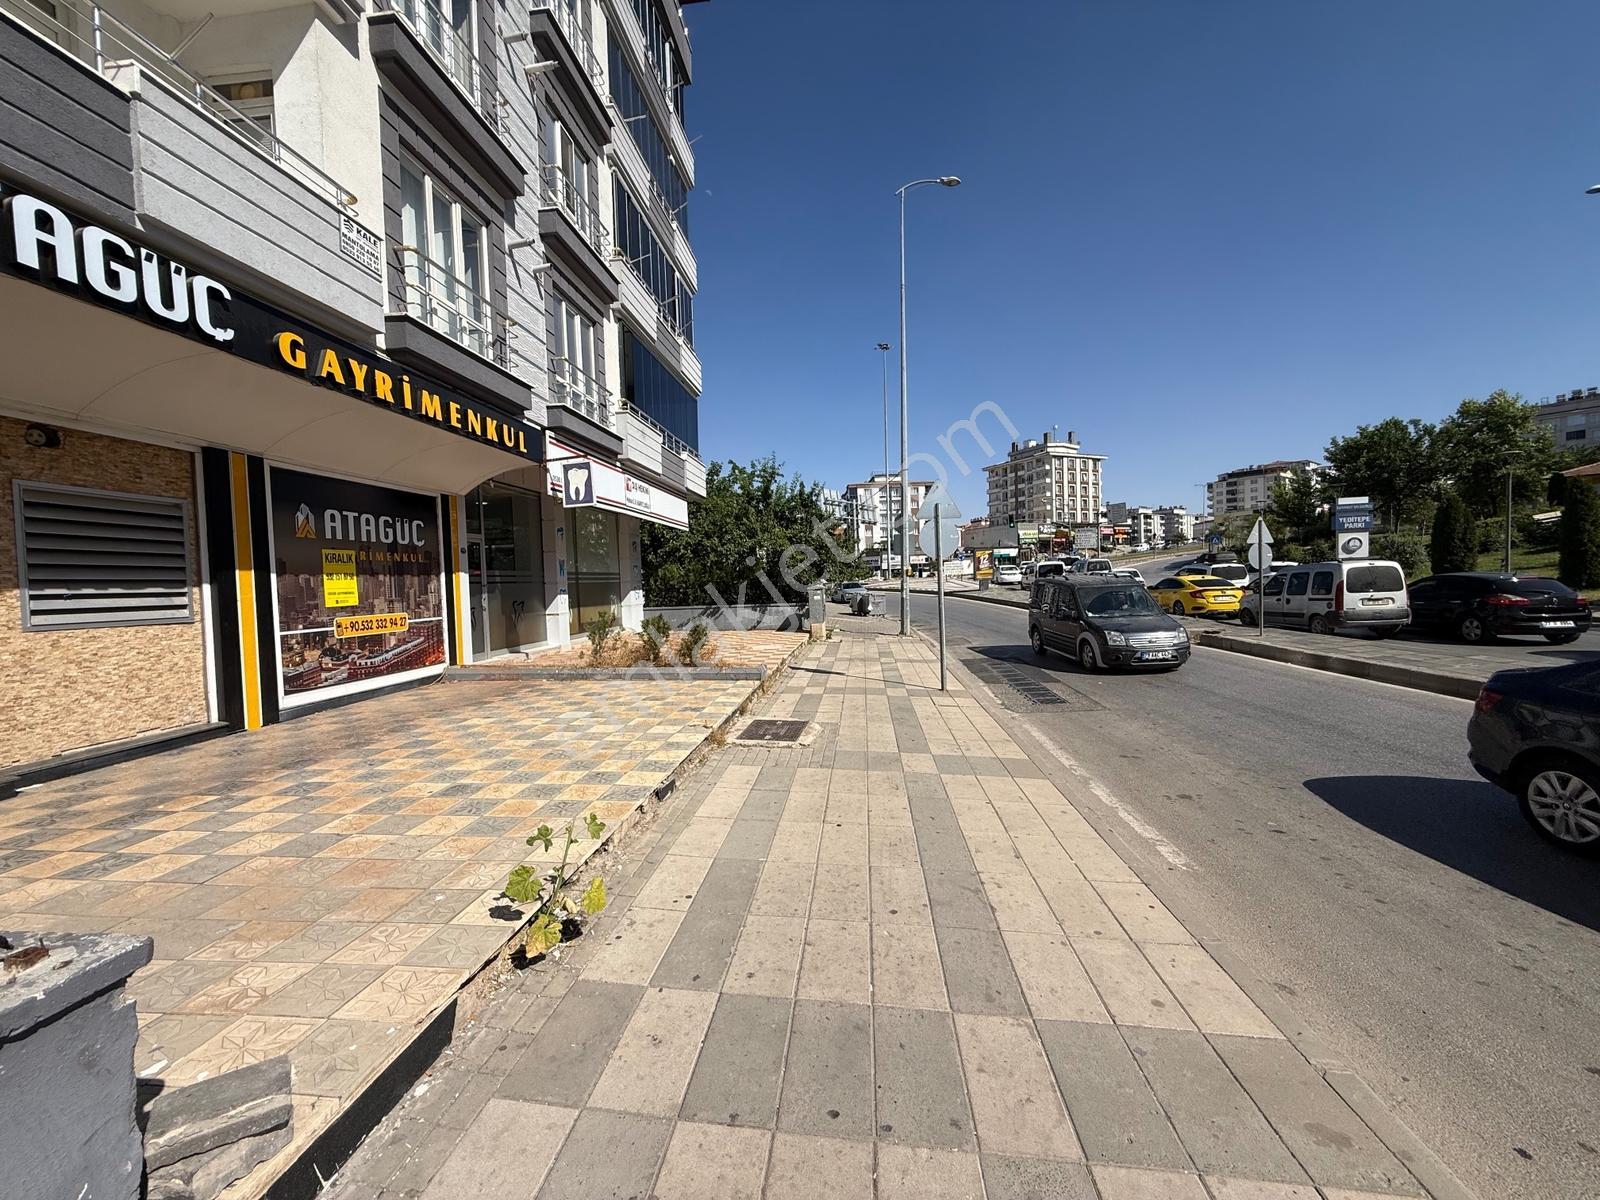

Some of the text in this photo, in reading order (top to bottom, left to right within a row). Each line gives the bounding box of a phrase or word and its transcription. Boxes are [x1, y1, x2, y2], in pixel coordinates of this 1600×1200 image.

[342, 232, 379, 261] MANTOLAMA
[356, 227, 379, 249] KALE
[277, 331, 529, 454] GAYRİMENKUL
[324, 509, 425, 547] ATAGÜÇ
[980, 554, 989, 565] 12
[375, 618, 388, 630] 332
[389, 617, 398, 628] 94
[399, 616, 407, 627] 27
